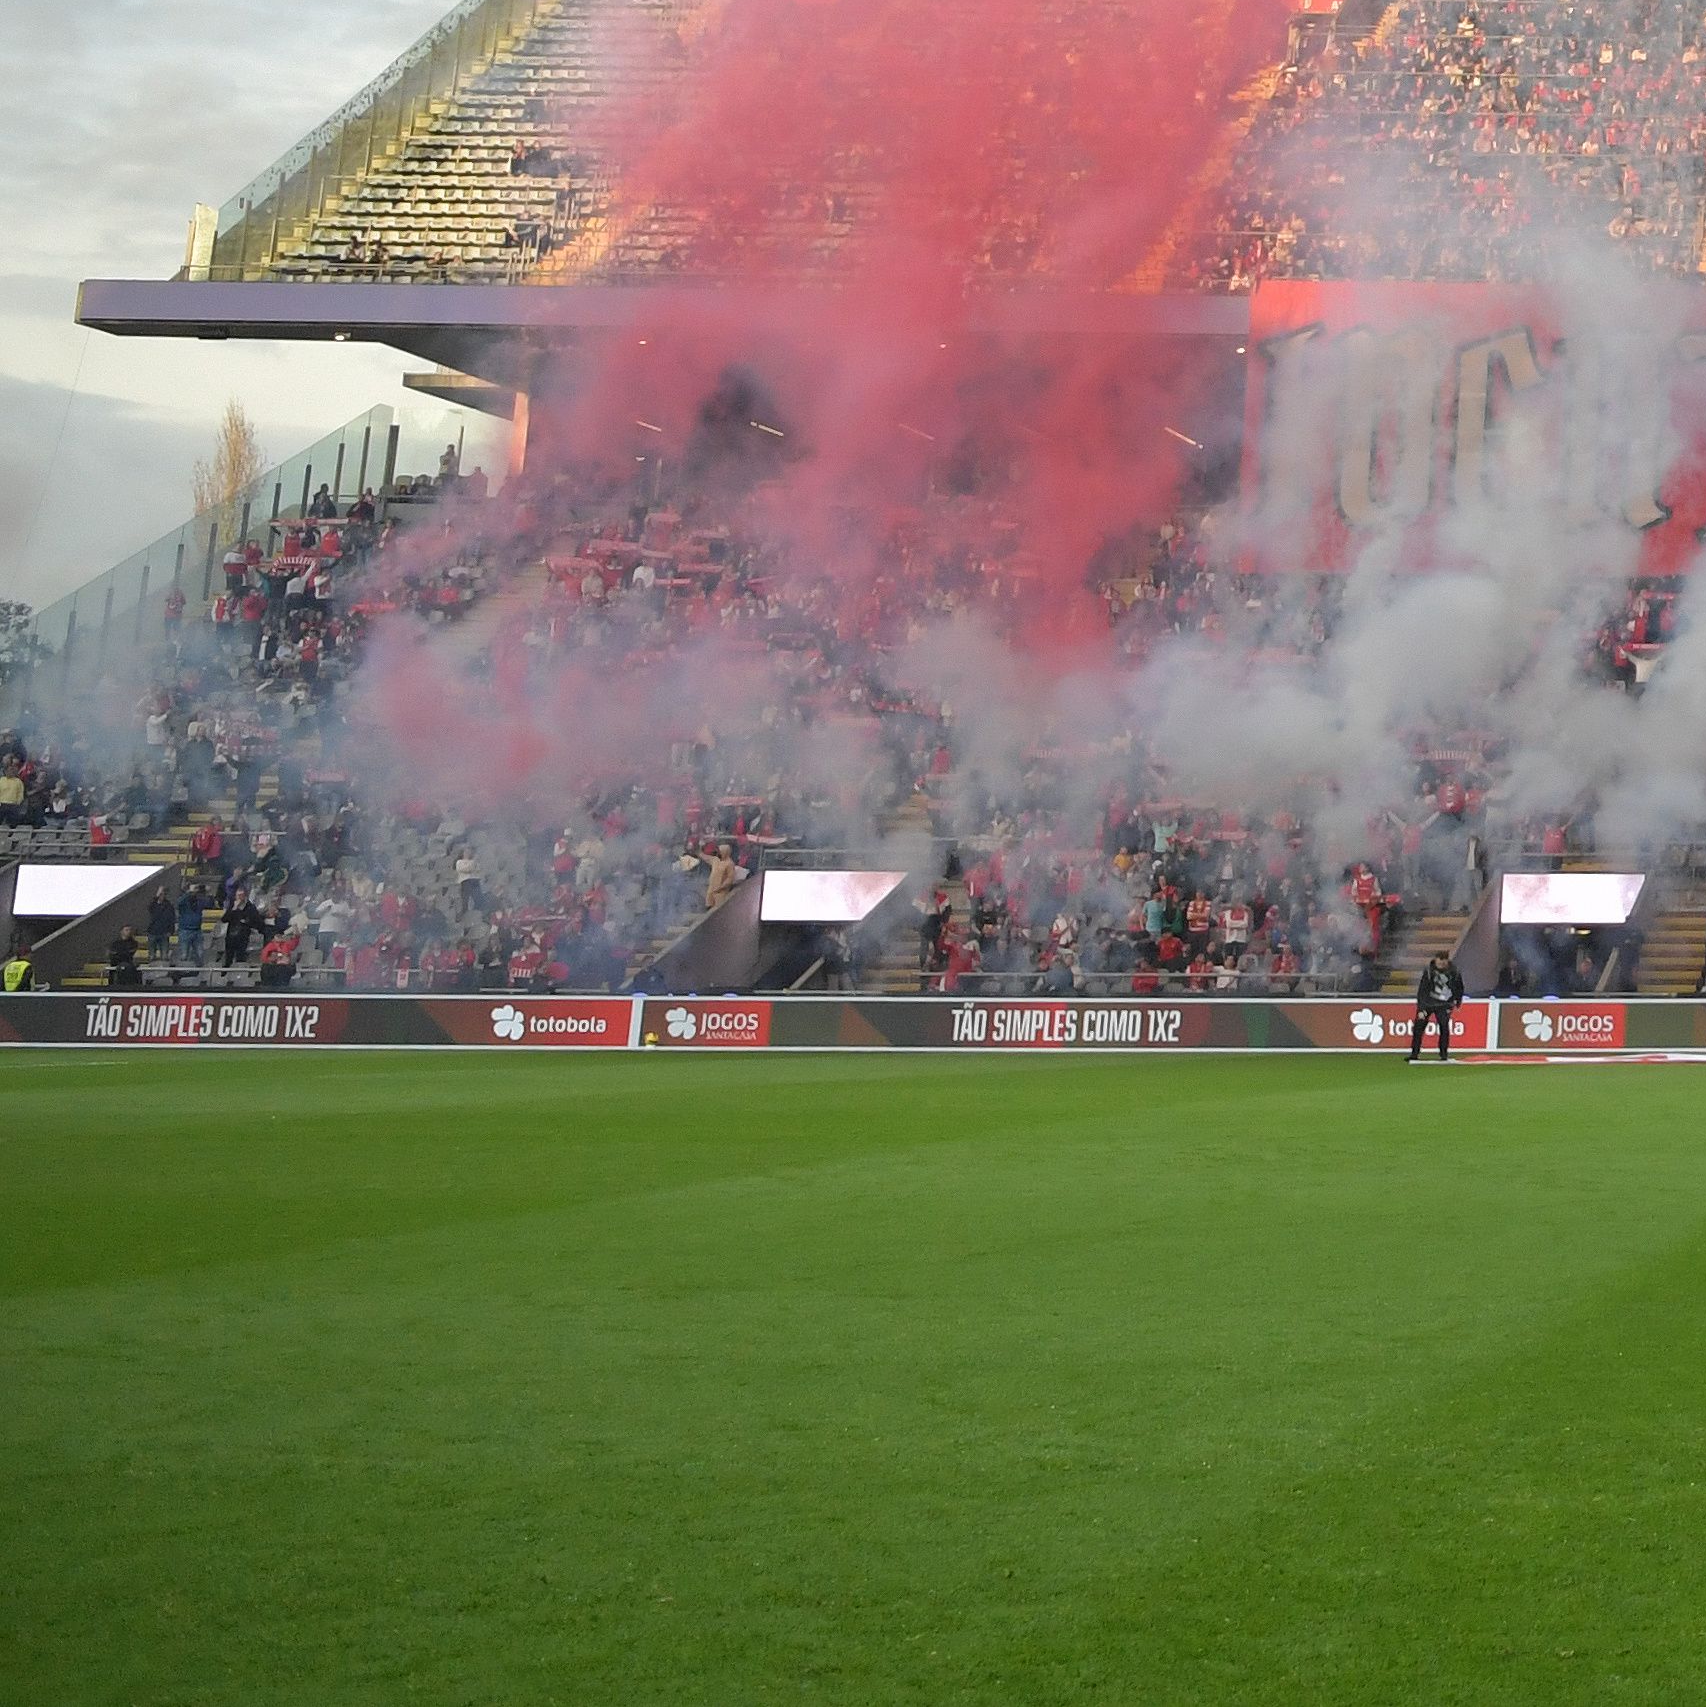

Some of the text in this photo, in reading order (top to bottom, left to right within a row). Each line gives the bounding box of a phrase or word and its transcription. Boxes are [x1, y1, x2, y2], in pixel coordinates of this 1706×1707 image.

[86, 998, 319, 1038] TÃO SIMPLES COMO 1X2
[530, 1015, 606, 1033] totobola
[700, 1012, 759, 1035] JOGOS
[952, 1002, 1180, 1041] TÃO SIMPLES COMO 1X2
[1556, 1014, 1615, 1038] JOGOS
